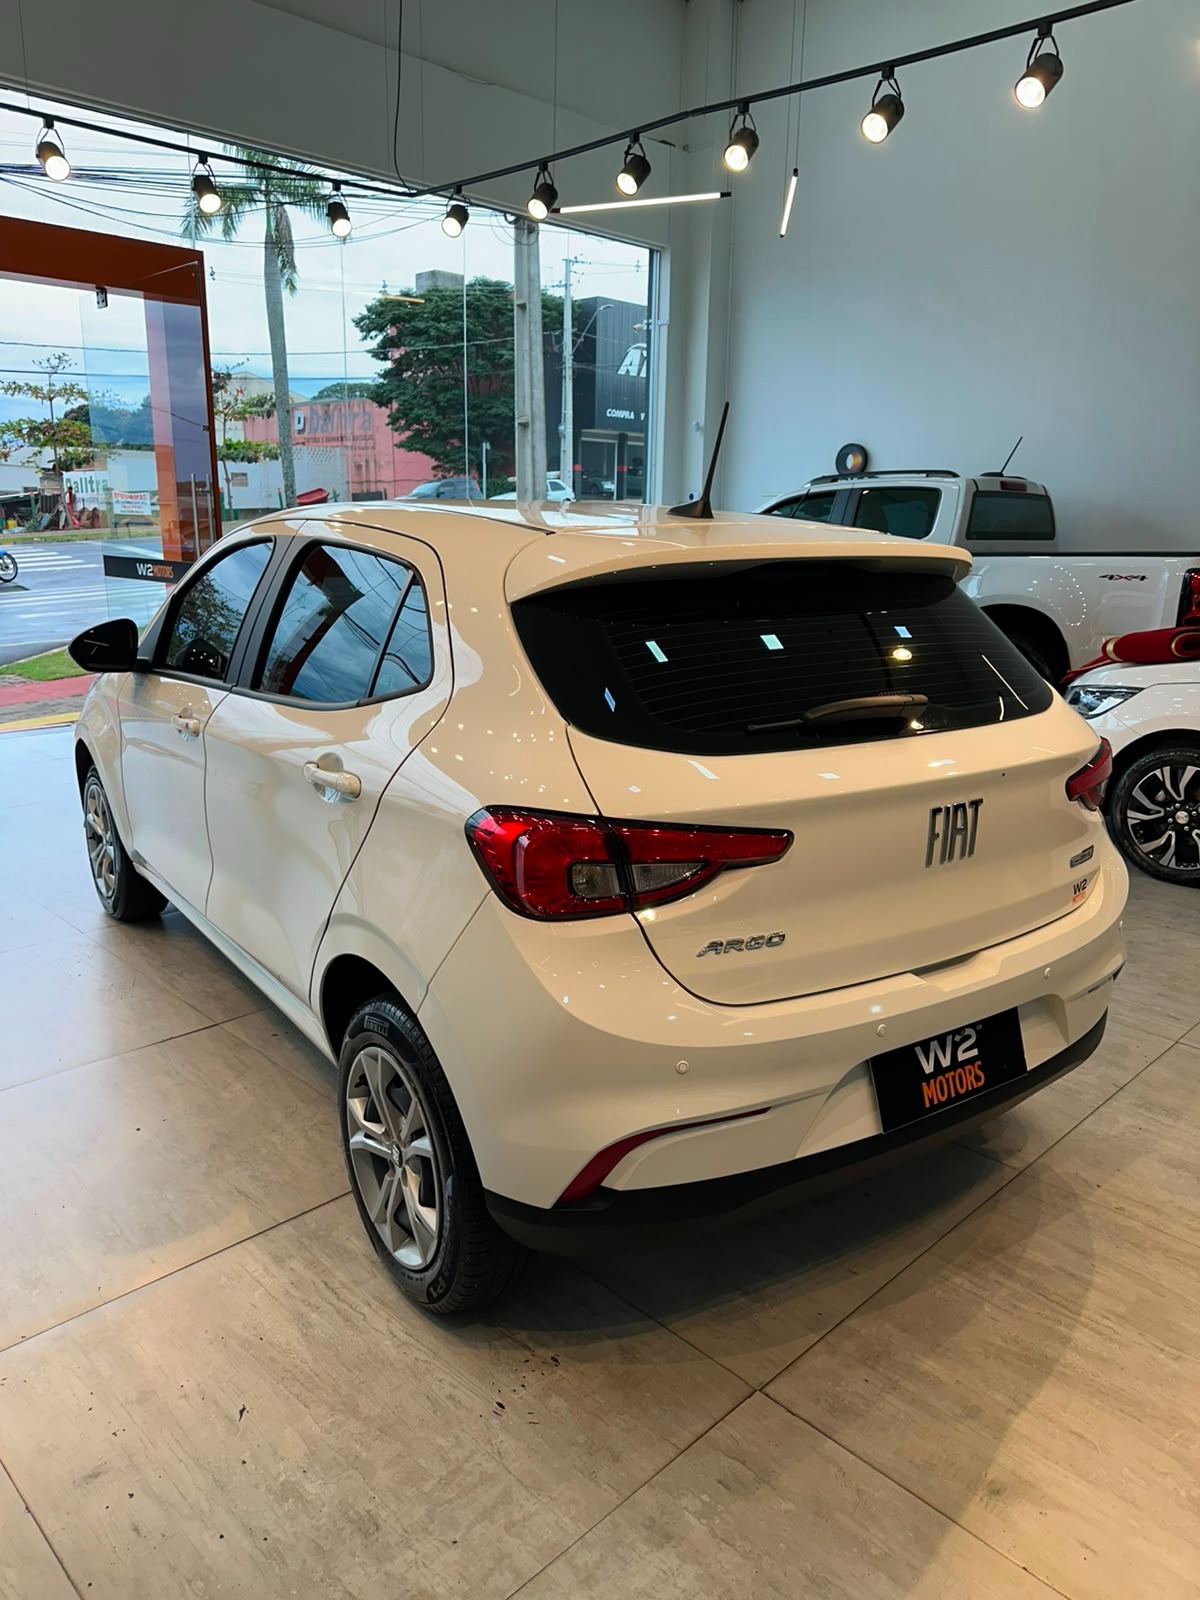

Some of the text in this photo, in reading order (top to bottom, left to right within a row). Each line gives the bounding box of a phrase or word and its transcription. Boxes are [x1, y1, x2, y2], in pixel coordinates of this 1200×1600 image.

[606, 408, 635, 420] COMPRA
[136, 563, 153, 577] W2
[925, 798, 983, 868] FIAT
[1073, 878, 1088, 895] W2
[696, 931, 786, 957] ARGO
[364, 1015, 389, 1037] PIRELLI
[914, 1028, 979, 1075] W2
[921, 1060, 985, 1108] MOTORS
